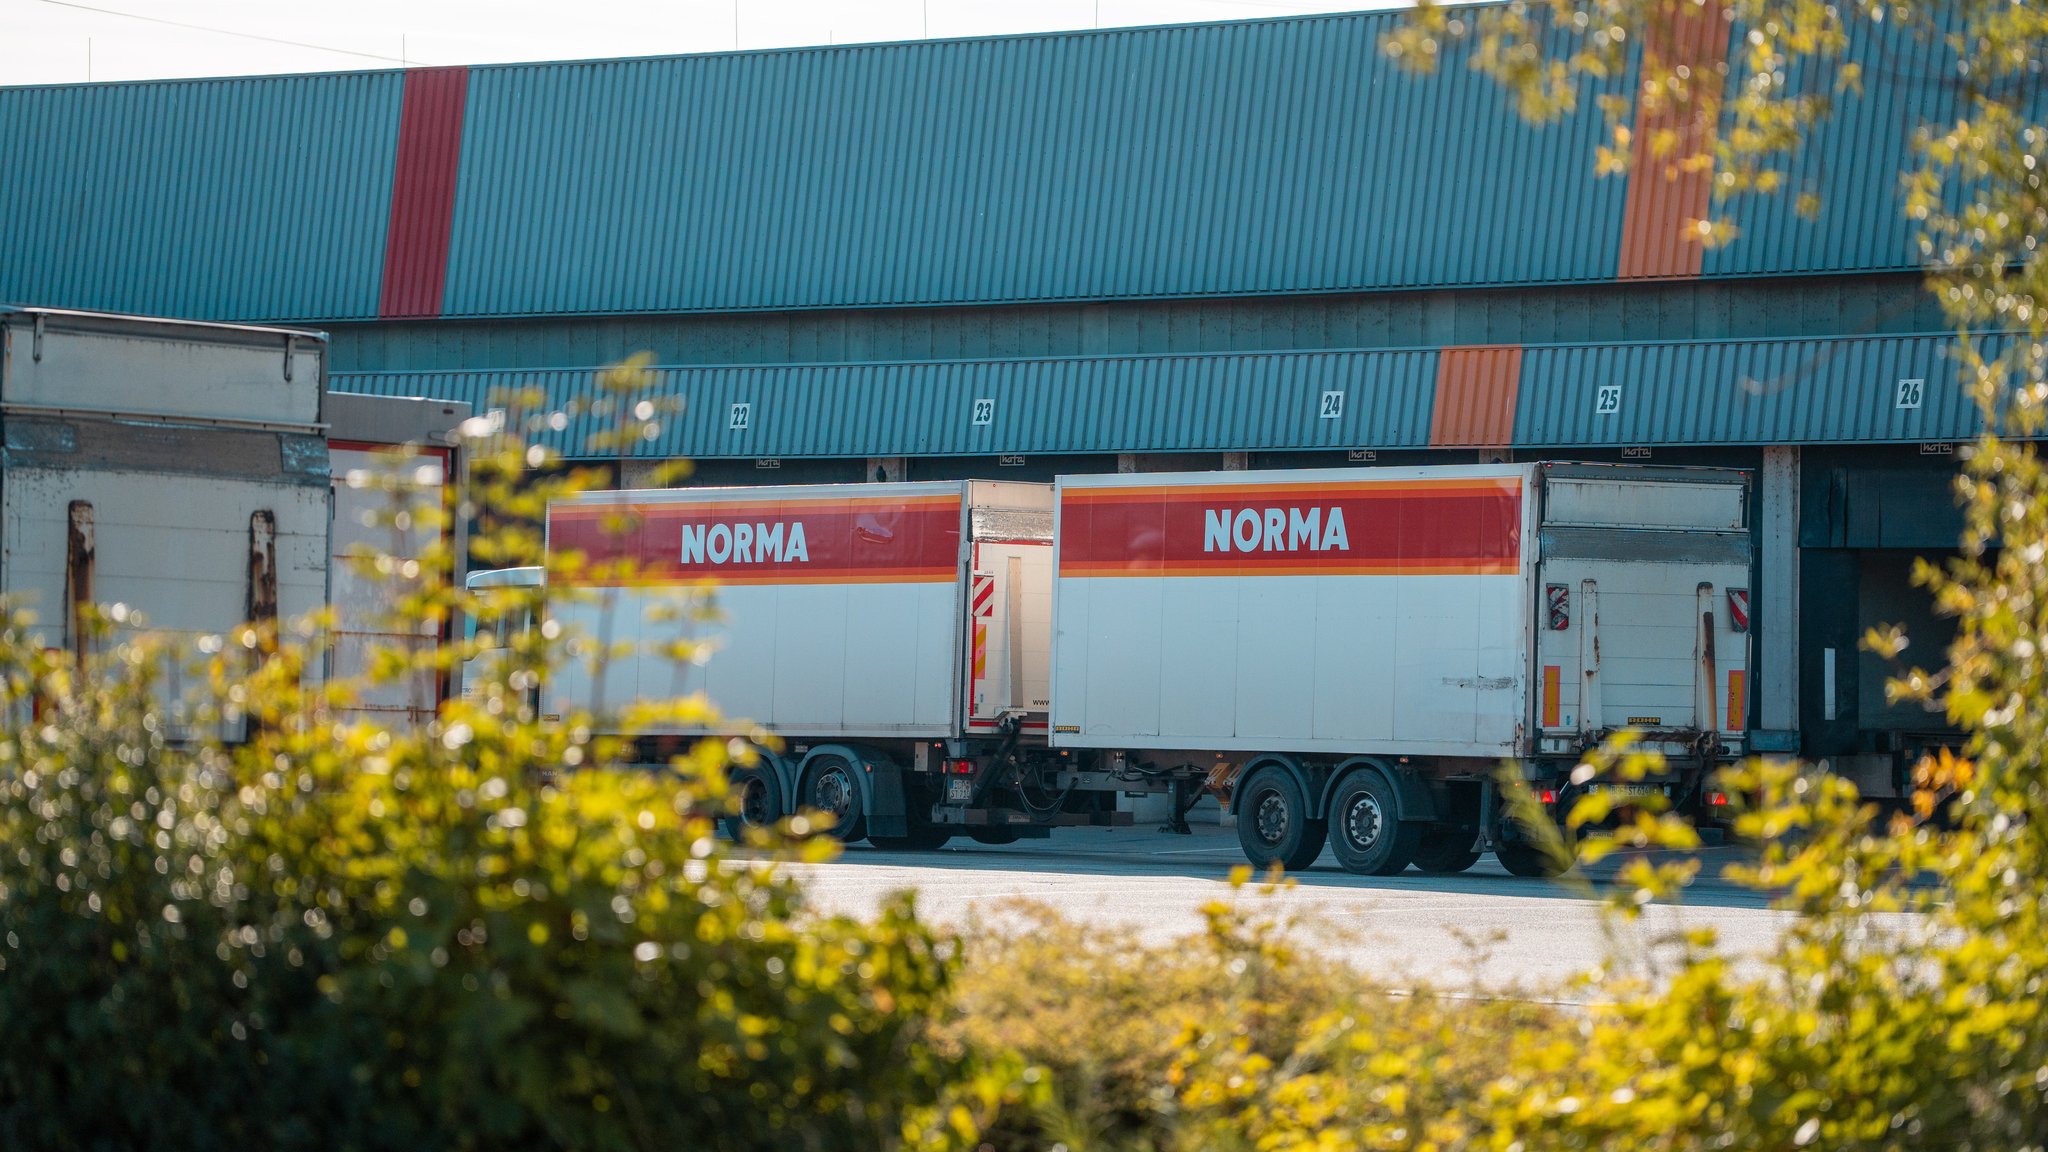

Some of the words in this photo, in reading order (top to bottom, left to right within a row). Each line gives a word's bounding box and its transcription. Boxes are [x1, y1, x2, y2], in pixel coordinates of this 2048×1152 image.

[1323, 394, 1341, 415] 24
[1599, 389, 1619, 410] 25
[1900, 383, 1920, 405] 26
[733, 406, 748, 425] 22
[975, 402, 992, 421] 23
[1204, 507, 1350, 552] NORMA
[681, 522, 809, 564] NORMA
